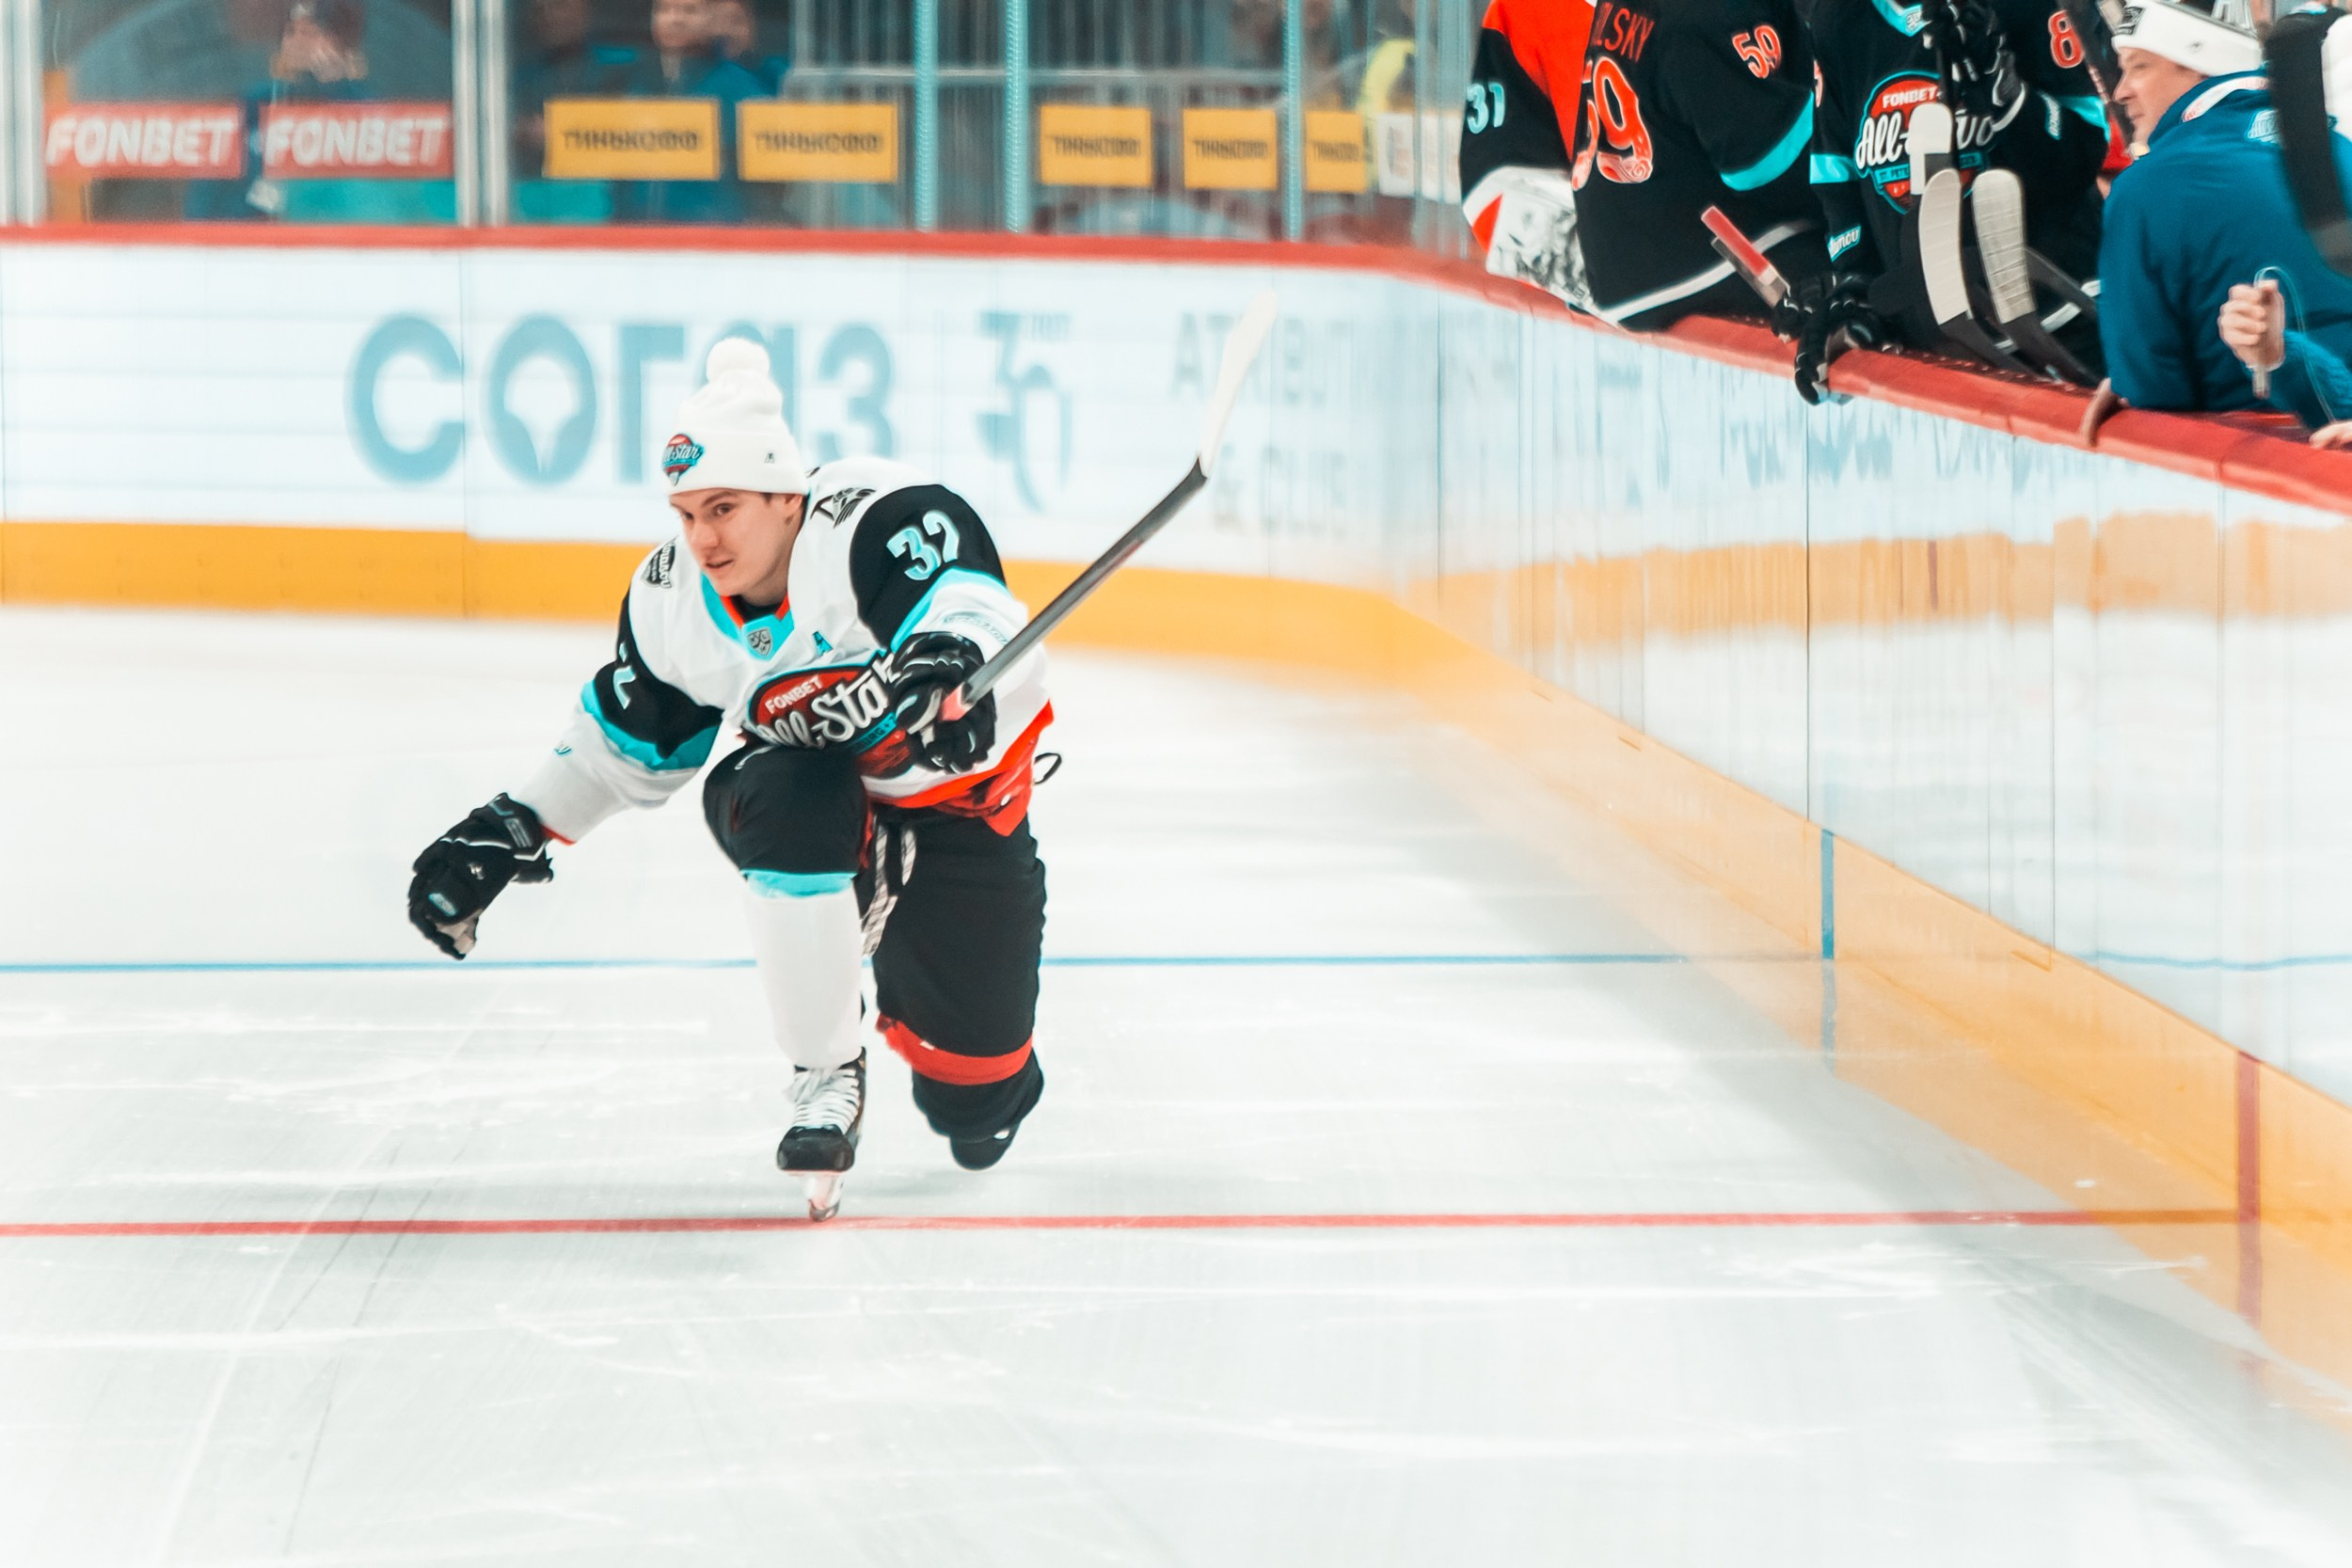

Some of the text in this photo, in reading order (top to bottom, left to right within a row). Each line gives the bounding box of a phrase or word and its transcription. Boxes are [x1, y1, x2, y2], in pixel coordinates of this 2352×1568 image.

[1732, 24, 1781, 79] 59
[1467, 81, 1505, 135] 31
[1883, 86, 1938, 109] FONBET
[45, 118, 239, 166] FONBET
[264, 118, 446, 166] FONBET
[886, 510, 961, 581] 32
[764, 673, 823, 715] FONBET
